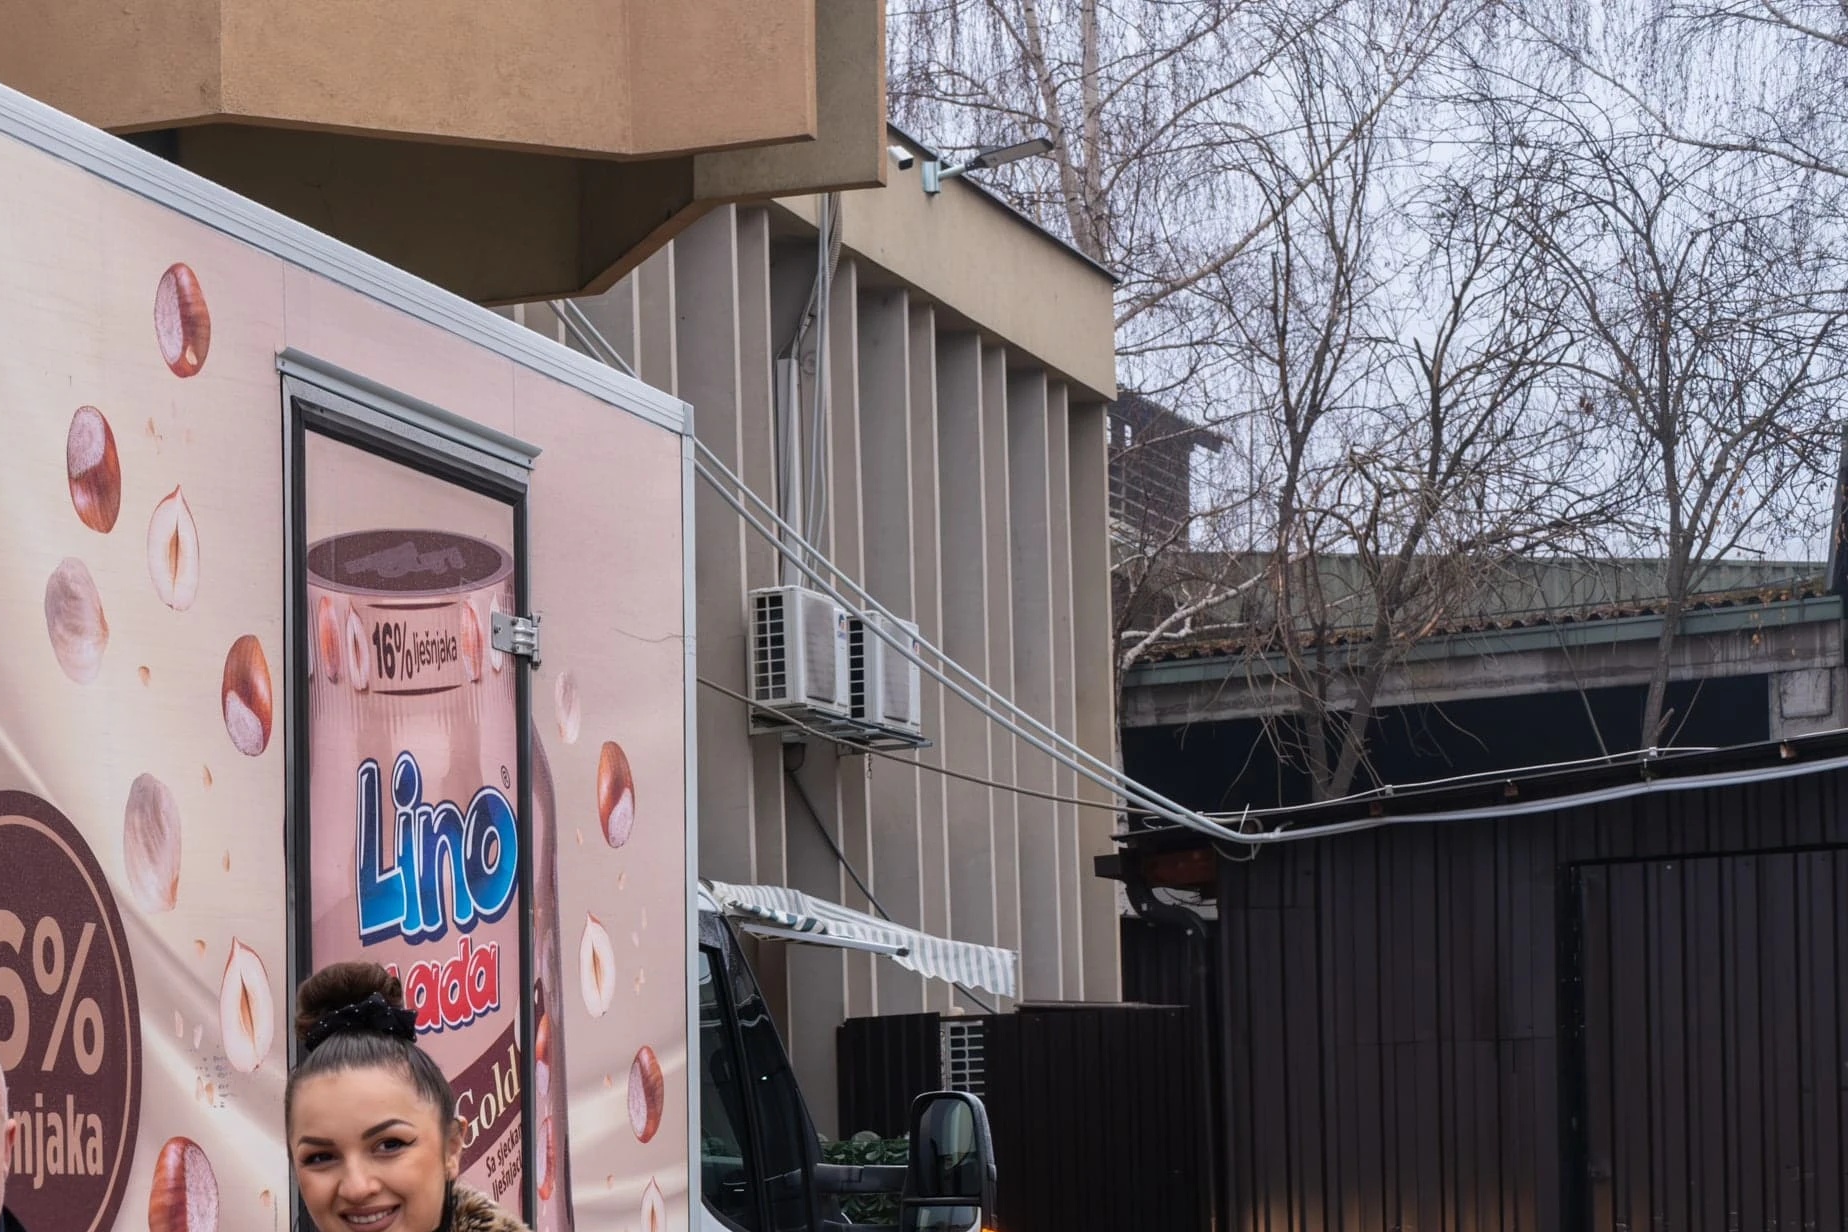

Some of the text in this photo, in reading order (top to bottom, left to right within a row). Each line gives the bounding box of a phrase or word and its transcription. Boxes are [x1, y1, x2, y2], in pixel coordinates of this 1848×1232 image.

[372, 621, 458, 681] 16% lješnjaka
[355, 750, 518, 946] Lino
[386, 934, 500, 1034] ada
[9, 1092, 104, 1190] njaka
[455, 1043, 521, 1149] Gold
[486, 1155, 496, 1178] Sa
